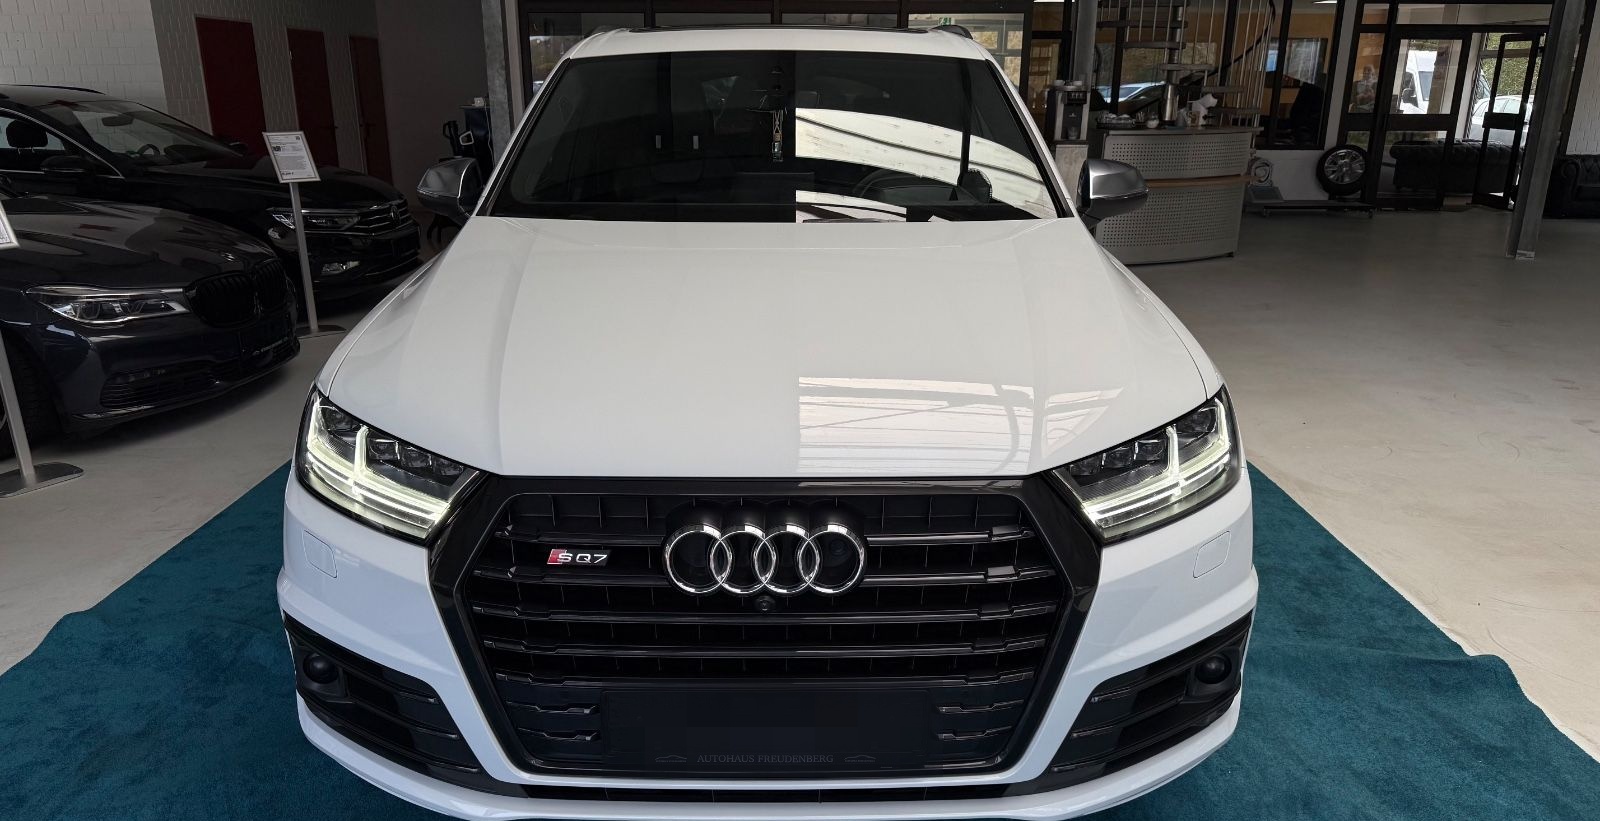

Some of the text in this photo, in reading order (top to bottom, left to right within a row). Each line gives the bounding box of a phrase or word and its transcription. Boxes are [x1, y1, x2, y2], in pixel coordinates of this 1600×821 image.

[556, 553, 608, 564] SQ7
[696, 754, 755, 763] AUTOHAUS
[757, 754, 834, 763] FREUDENBERG
